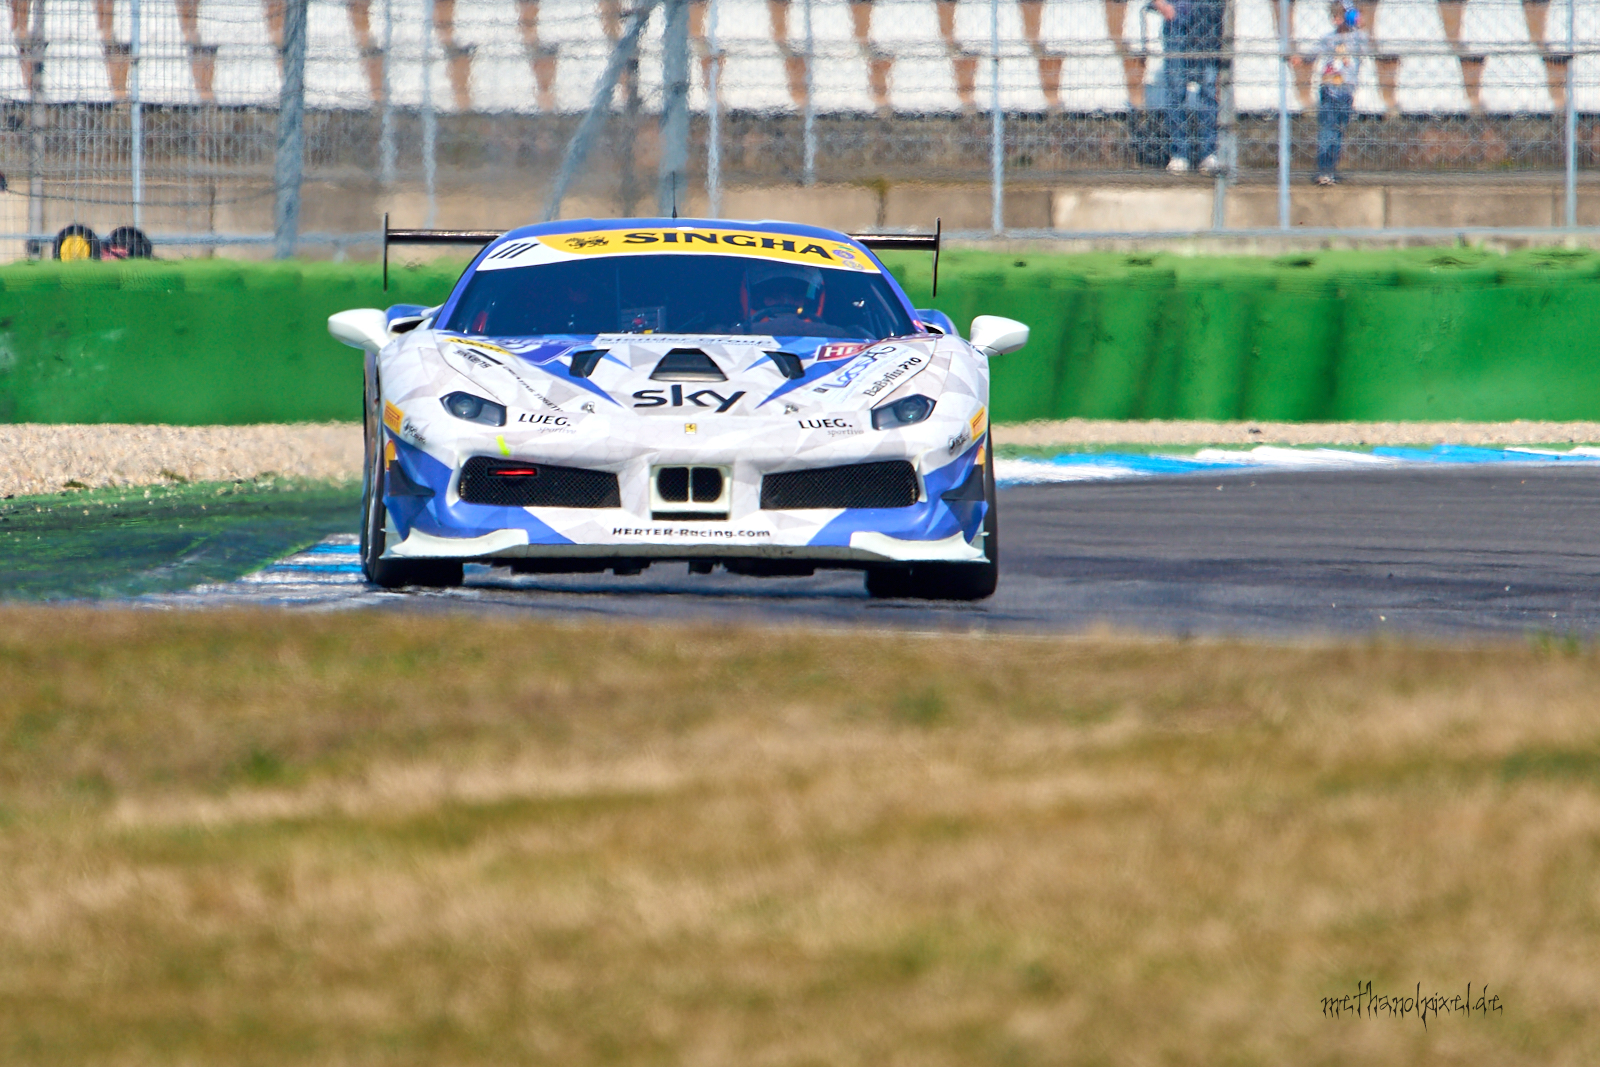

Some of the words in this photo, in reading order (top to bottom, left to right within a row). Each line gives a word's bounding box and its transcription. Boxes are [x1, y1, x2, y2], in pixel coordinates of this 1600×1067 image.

[623, 231, 834, 261] SINGHA
[631, 384, 747, 413] sky
[612, 527, 771, 538] HERTER-Racing.com
